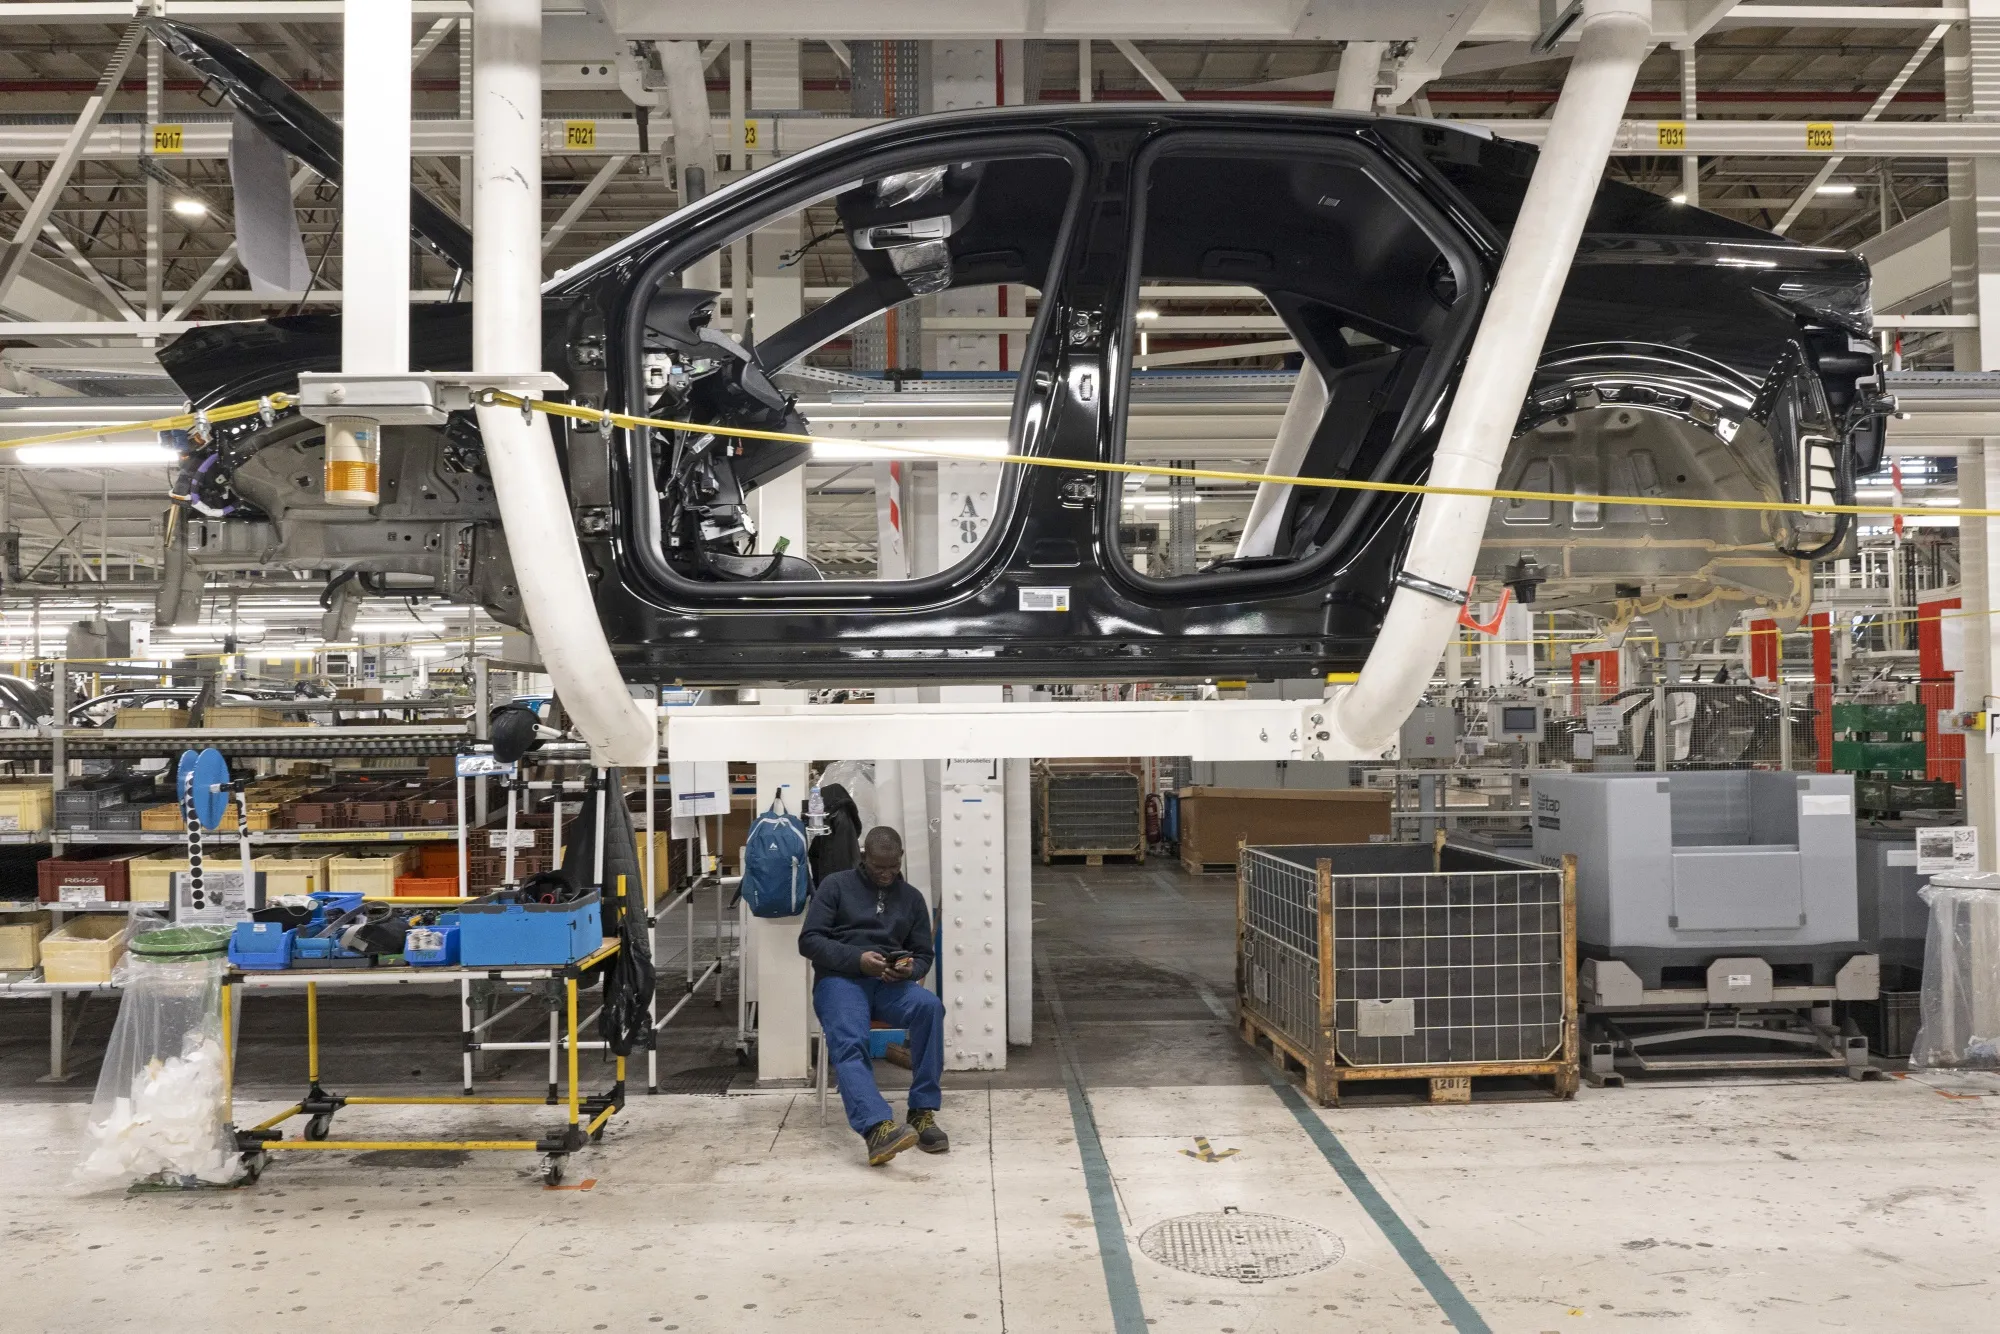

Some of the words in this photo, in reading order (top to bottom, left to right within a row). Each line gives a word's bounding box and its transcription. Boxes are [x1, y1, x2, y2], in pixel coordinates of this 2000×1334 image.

[155, 132, 180, 149] F017
[568, 127, 593, 144] F021
[1659, 128, 1683, 145] F031
[1808, 130, 1832, 146] F033
